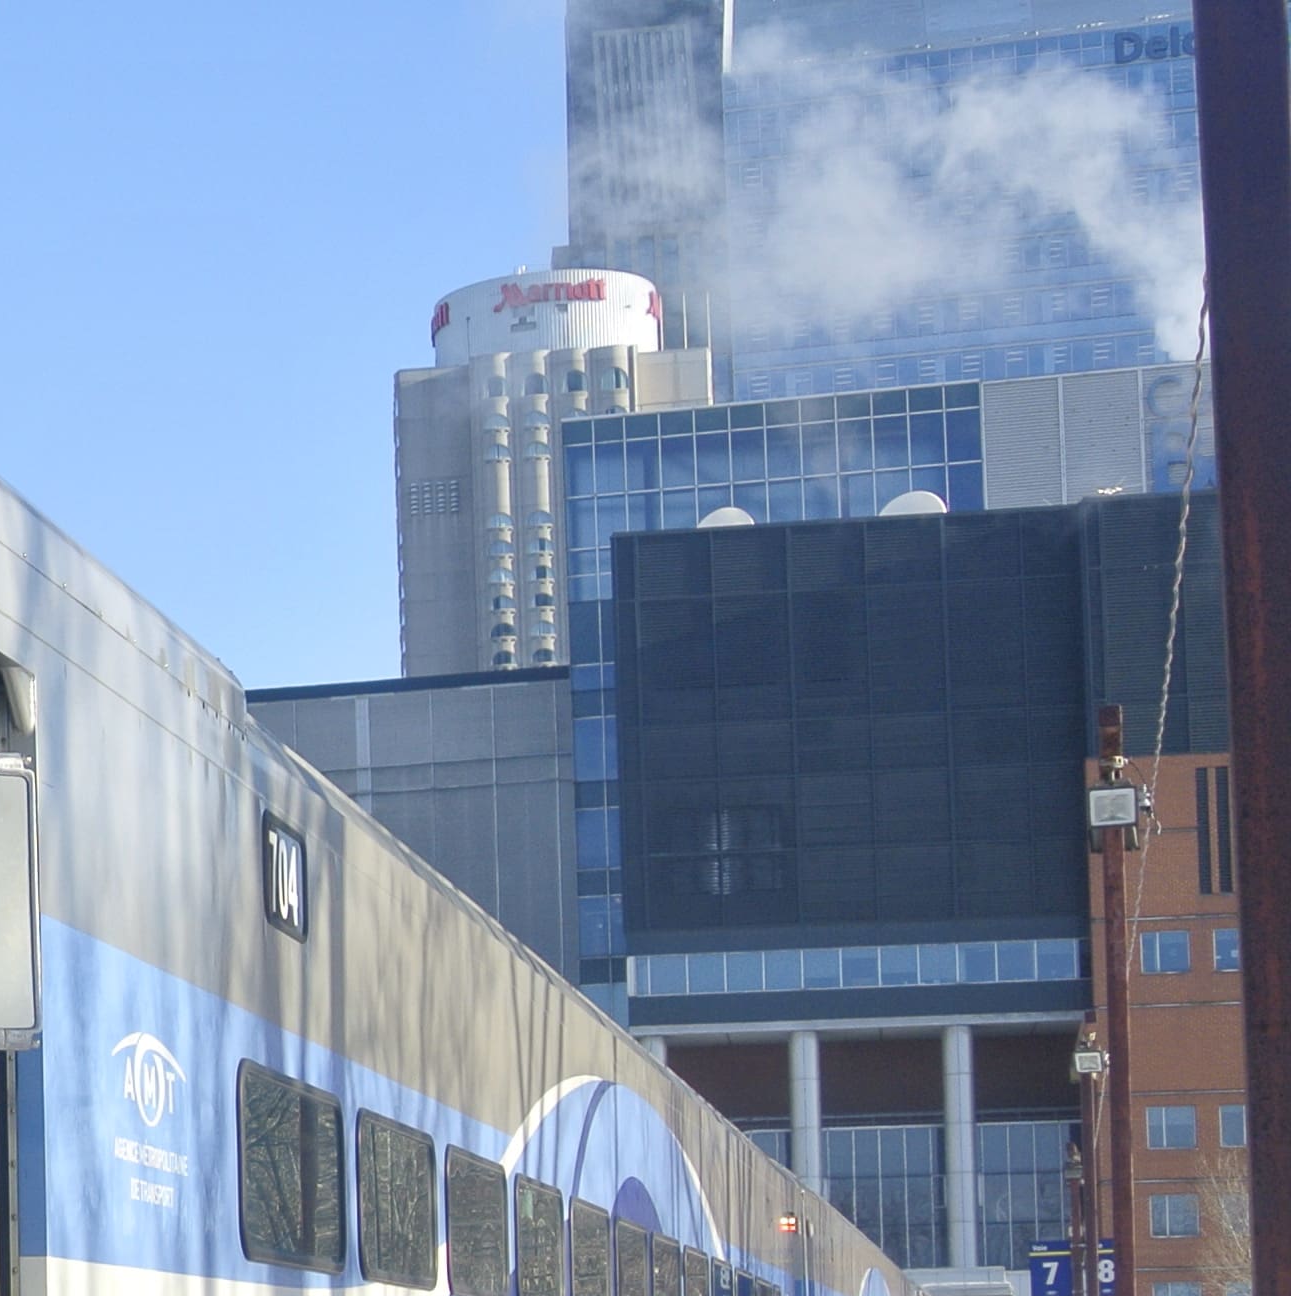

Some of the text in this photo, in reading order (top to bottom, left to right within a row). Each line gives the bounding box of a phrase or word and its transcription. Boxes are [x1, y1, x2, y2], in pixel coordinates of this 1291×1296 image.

[493, 278, 607, 313] Marriott
[268, 829, 299, 927] 704
[1042, 1262, 1059, 1285] 7
[1098, 1259, 1115, 1283] 8
